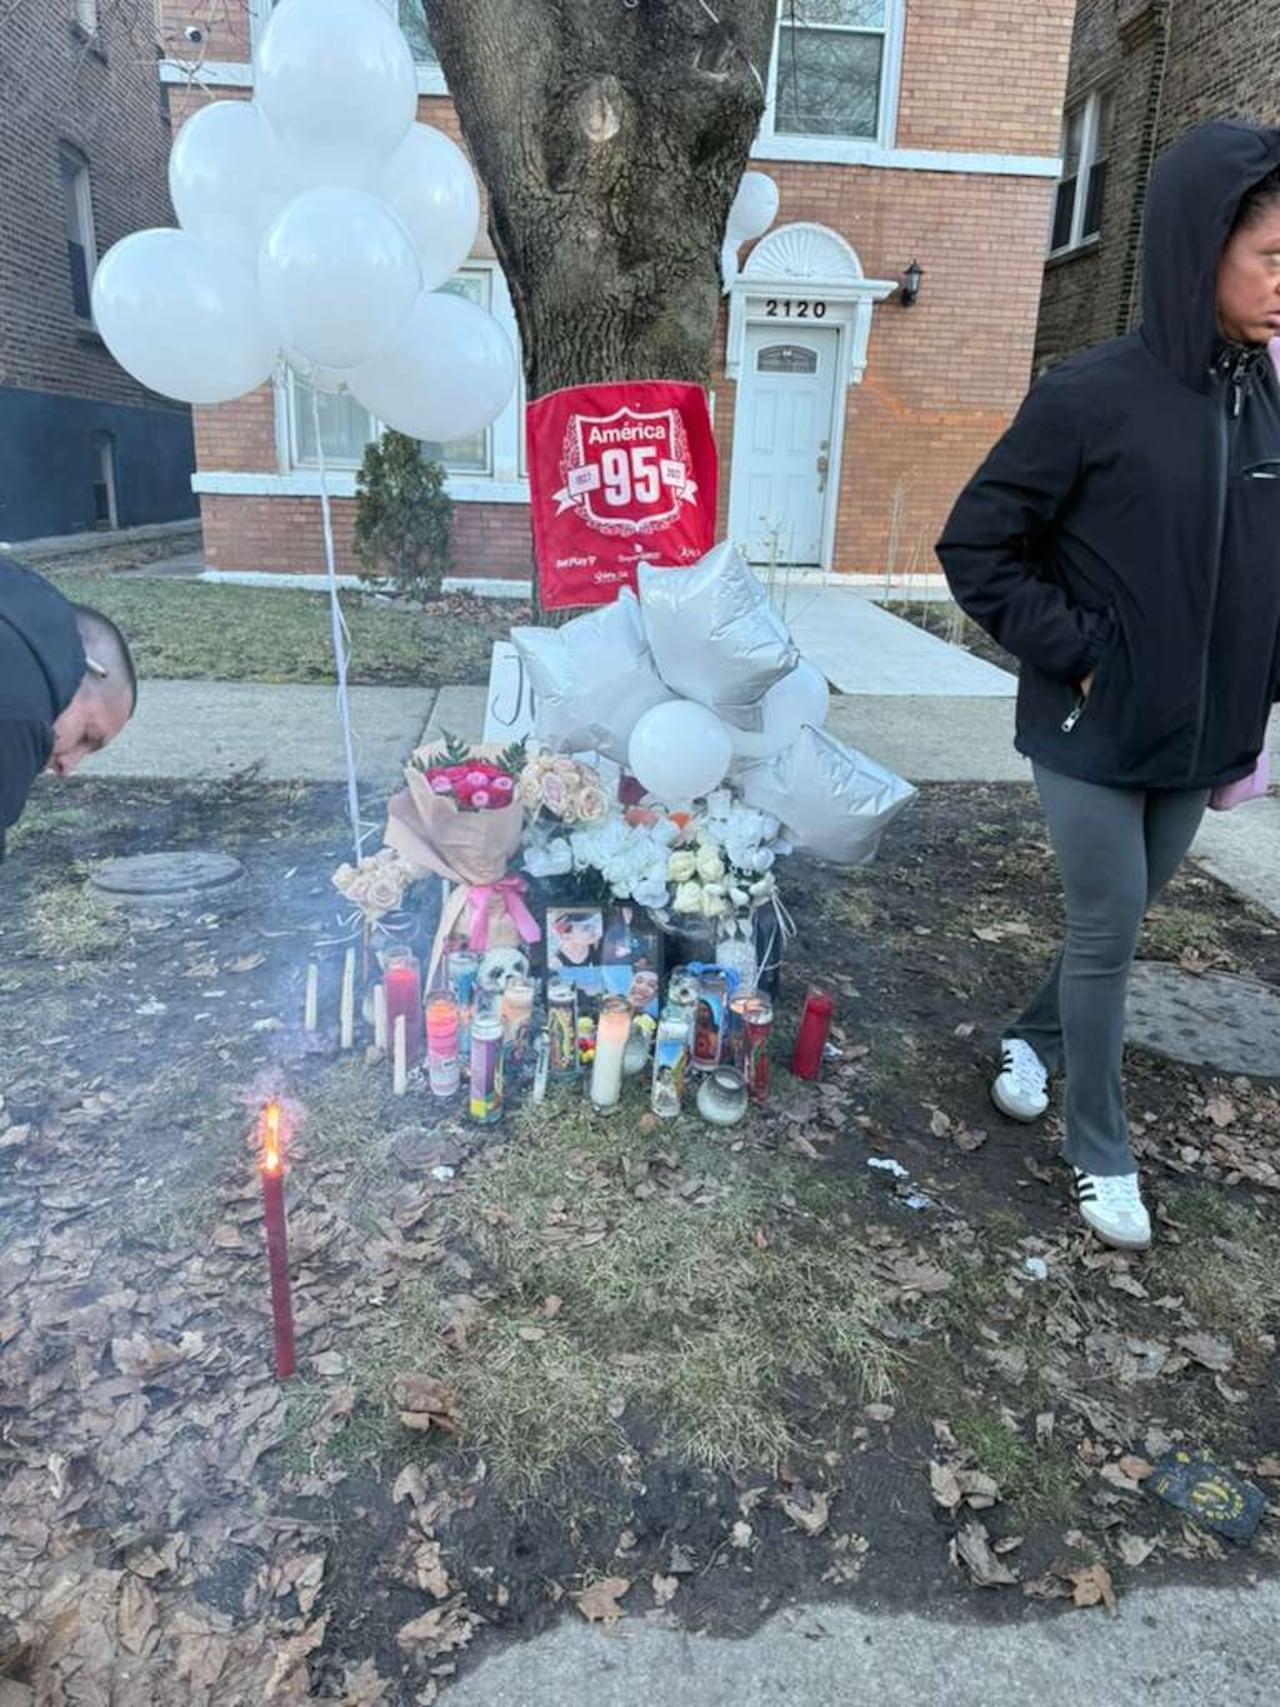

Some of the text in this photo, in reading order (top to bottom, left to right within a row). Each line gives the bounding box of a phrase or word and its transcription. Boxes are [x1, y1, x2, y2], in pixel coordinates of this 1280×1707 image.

[766, 299, 826, 318] 2120
[588, 421, 666, 445] América
[601, 446, 661, 507] 95
